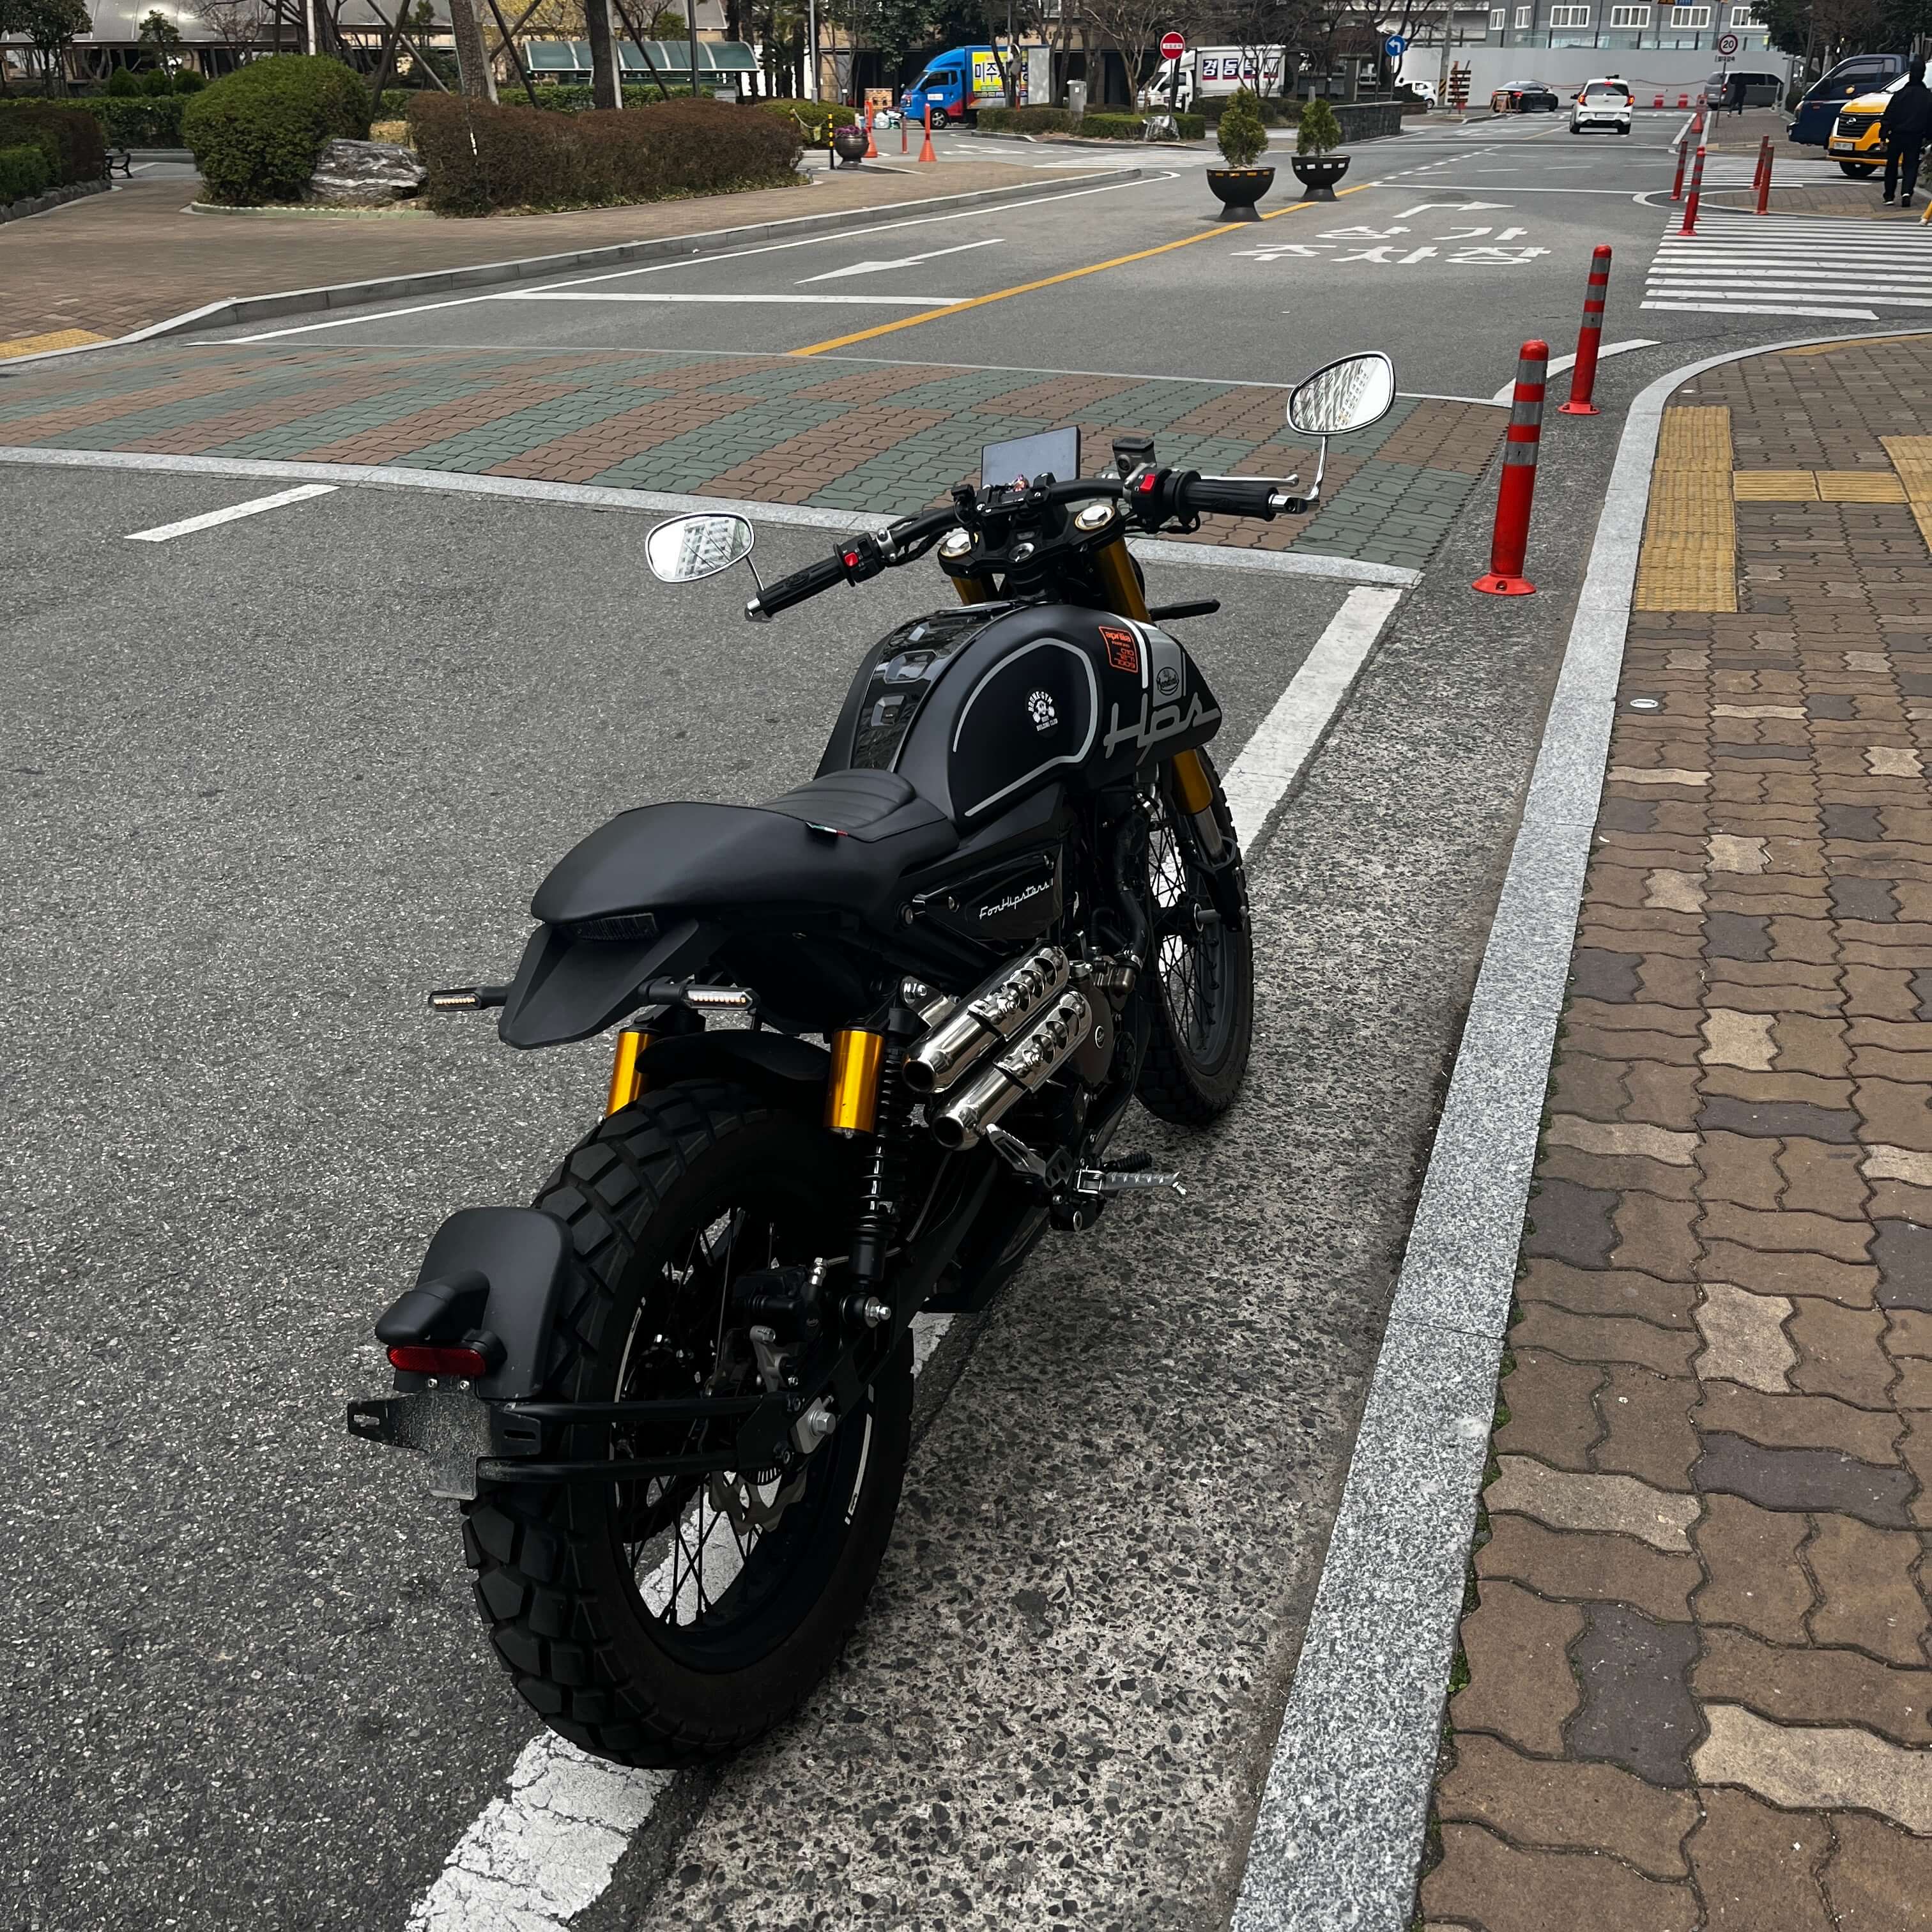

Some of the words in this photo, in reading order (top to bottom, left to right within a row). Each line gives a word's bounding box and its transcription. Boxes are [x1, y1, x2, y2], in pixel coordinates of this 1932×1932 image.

[1722, 40, 1734, 49] 20
[1315, 226, 1529, 240] 상가
[1230, 244, 1552, 265] 주차장
